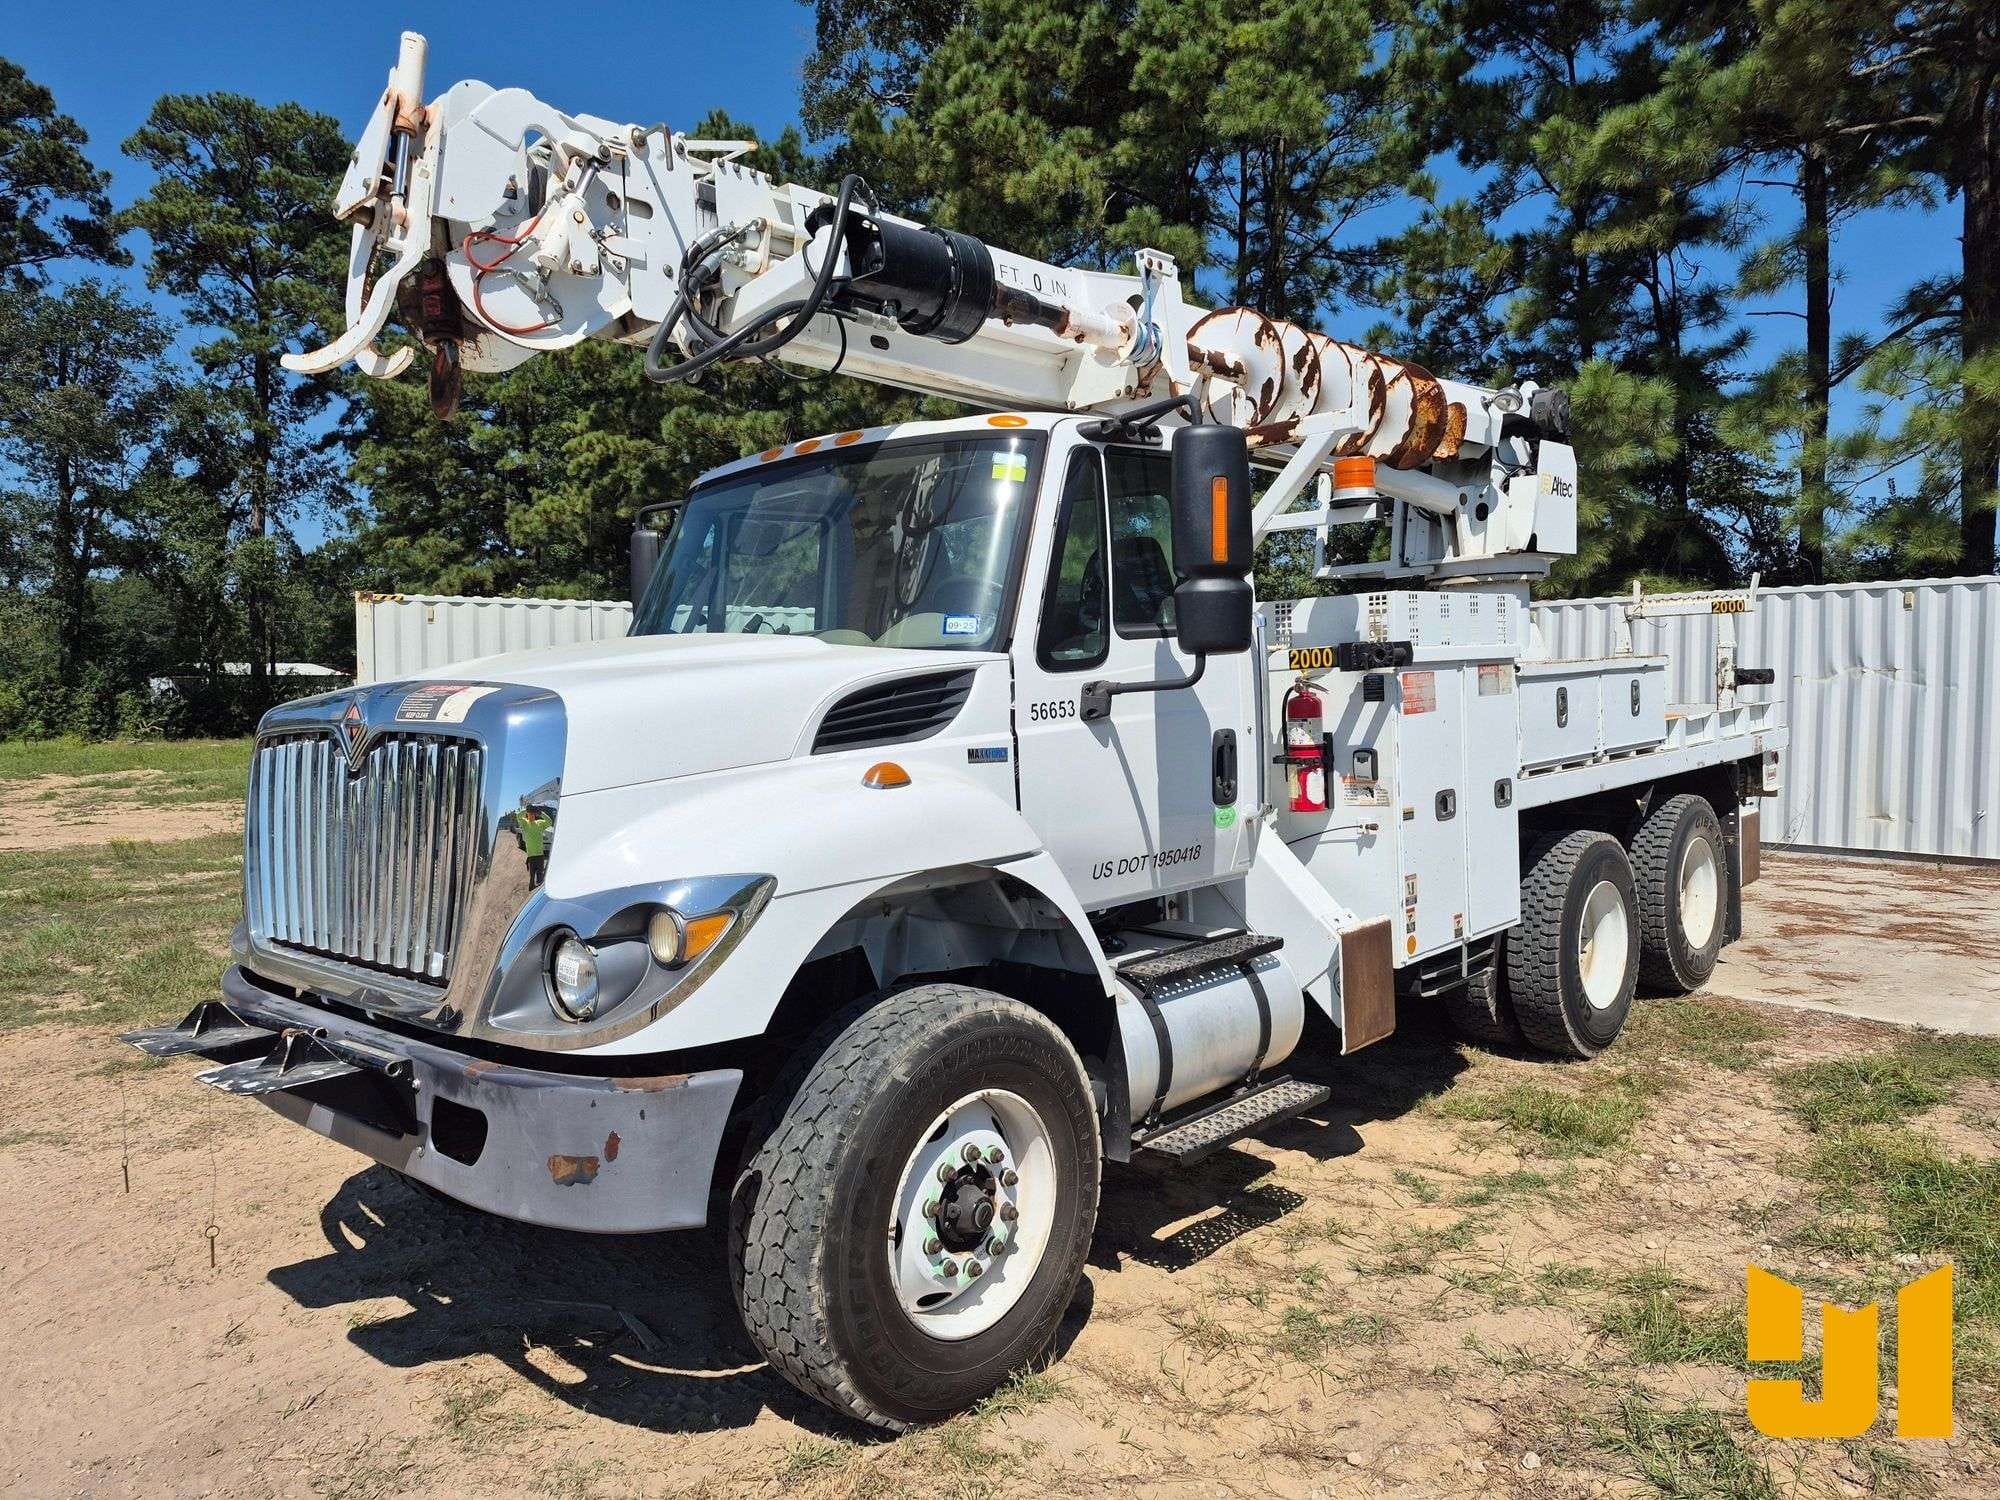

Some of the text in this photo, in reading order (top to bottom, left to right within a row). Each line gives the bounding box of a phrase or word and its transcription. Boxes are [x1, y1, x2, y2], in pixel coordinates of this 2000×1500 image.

[1000, 264, 1023, 285] FT.
[1551, 476, 1573, 498] Altec
[1712, 600, 1744, 613] 2000
[1290, 648, 1333, 669] 2000
[1031, 700, 1076, 721] 56653
[1092, 844, 1202, 880] US DOT 1950418
